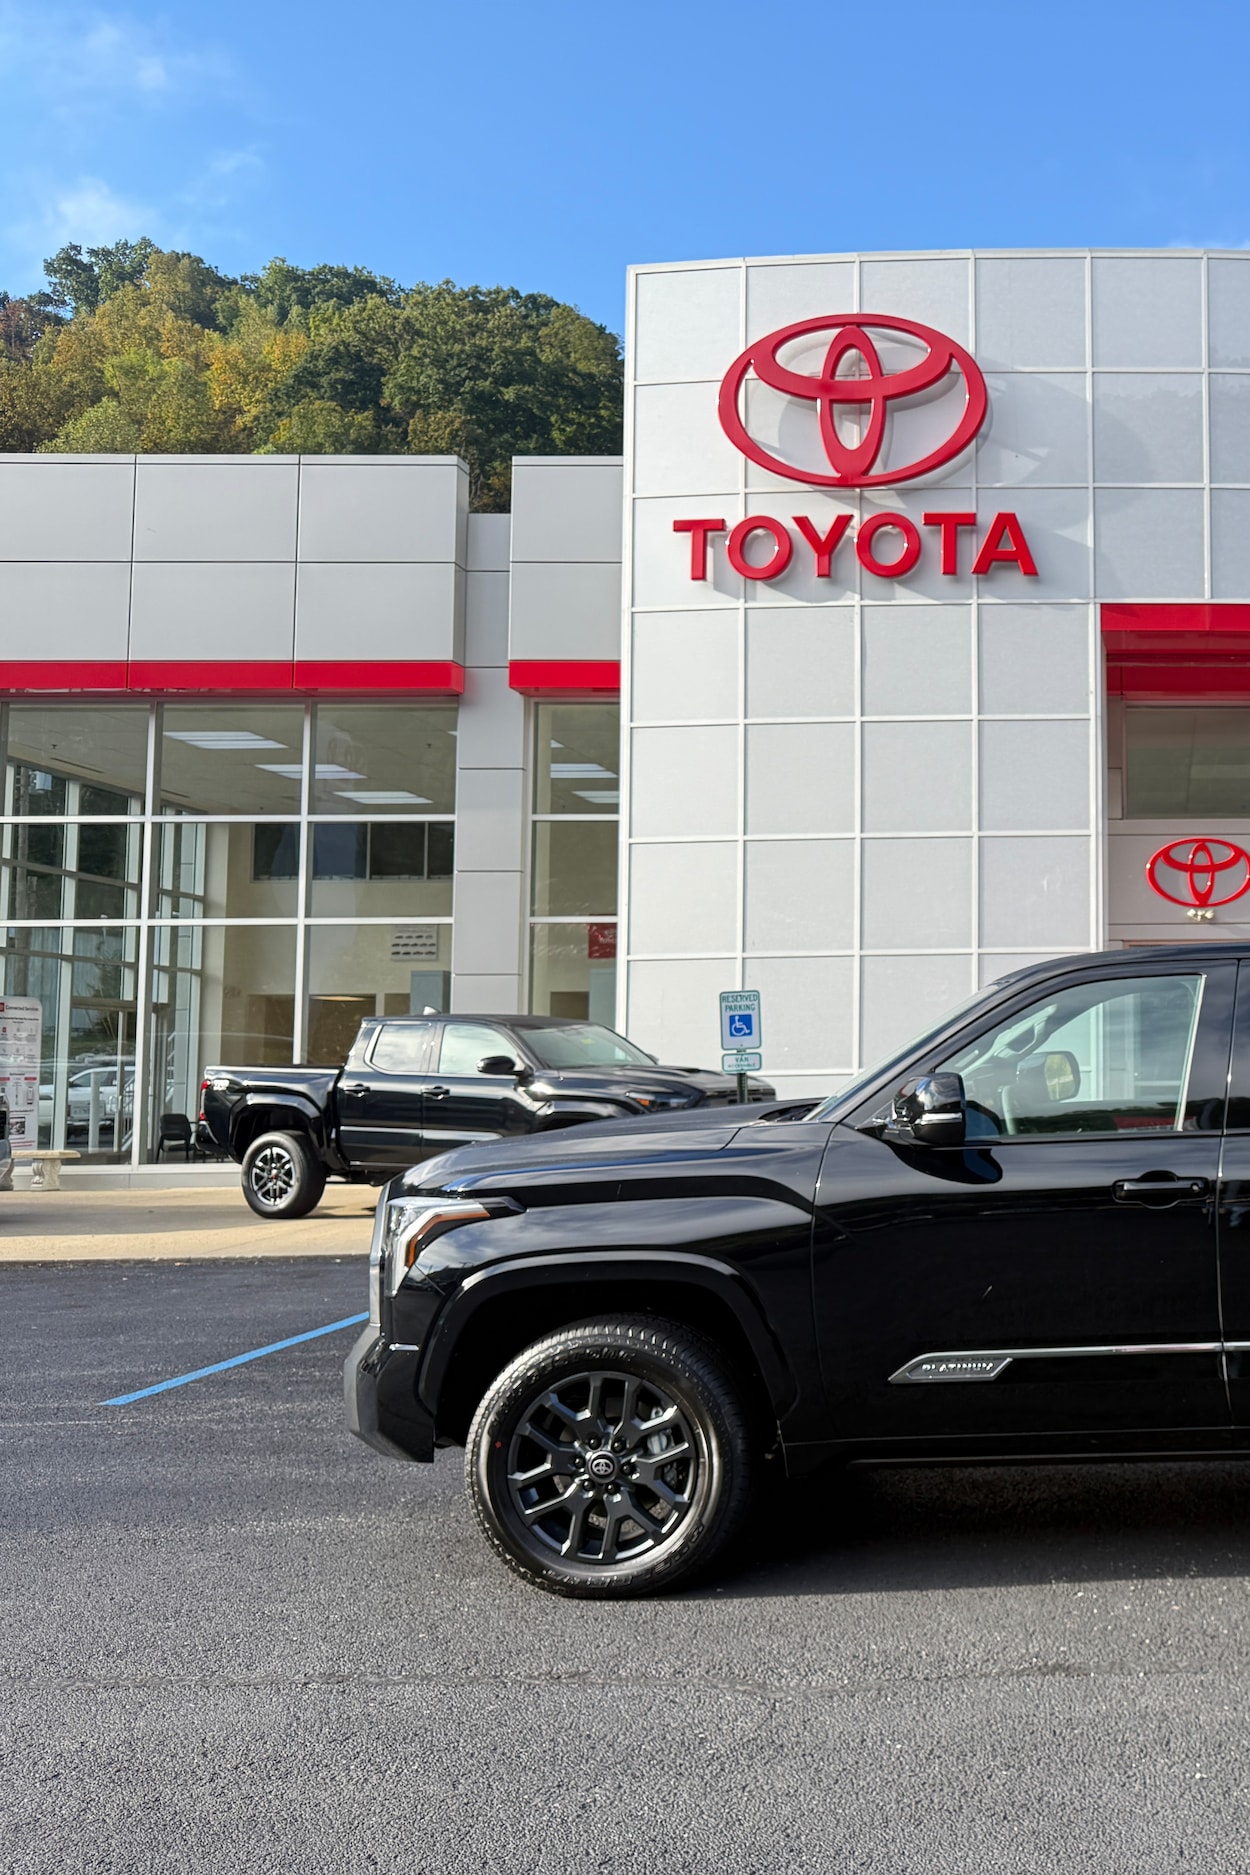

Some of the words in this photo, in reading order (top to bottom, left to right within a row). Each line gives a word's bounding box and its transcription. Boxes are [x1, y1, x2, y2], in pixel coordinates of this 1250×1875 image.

[673, 512, 1039, 581] TOYOTA
[722, 994, 758, 1003] RESERVED
[725, 1003, 756, 1012] PARKING
